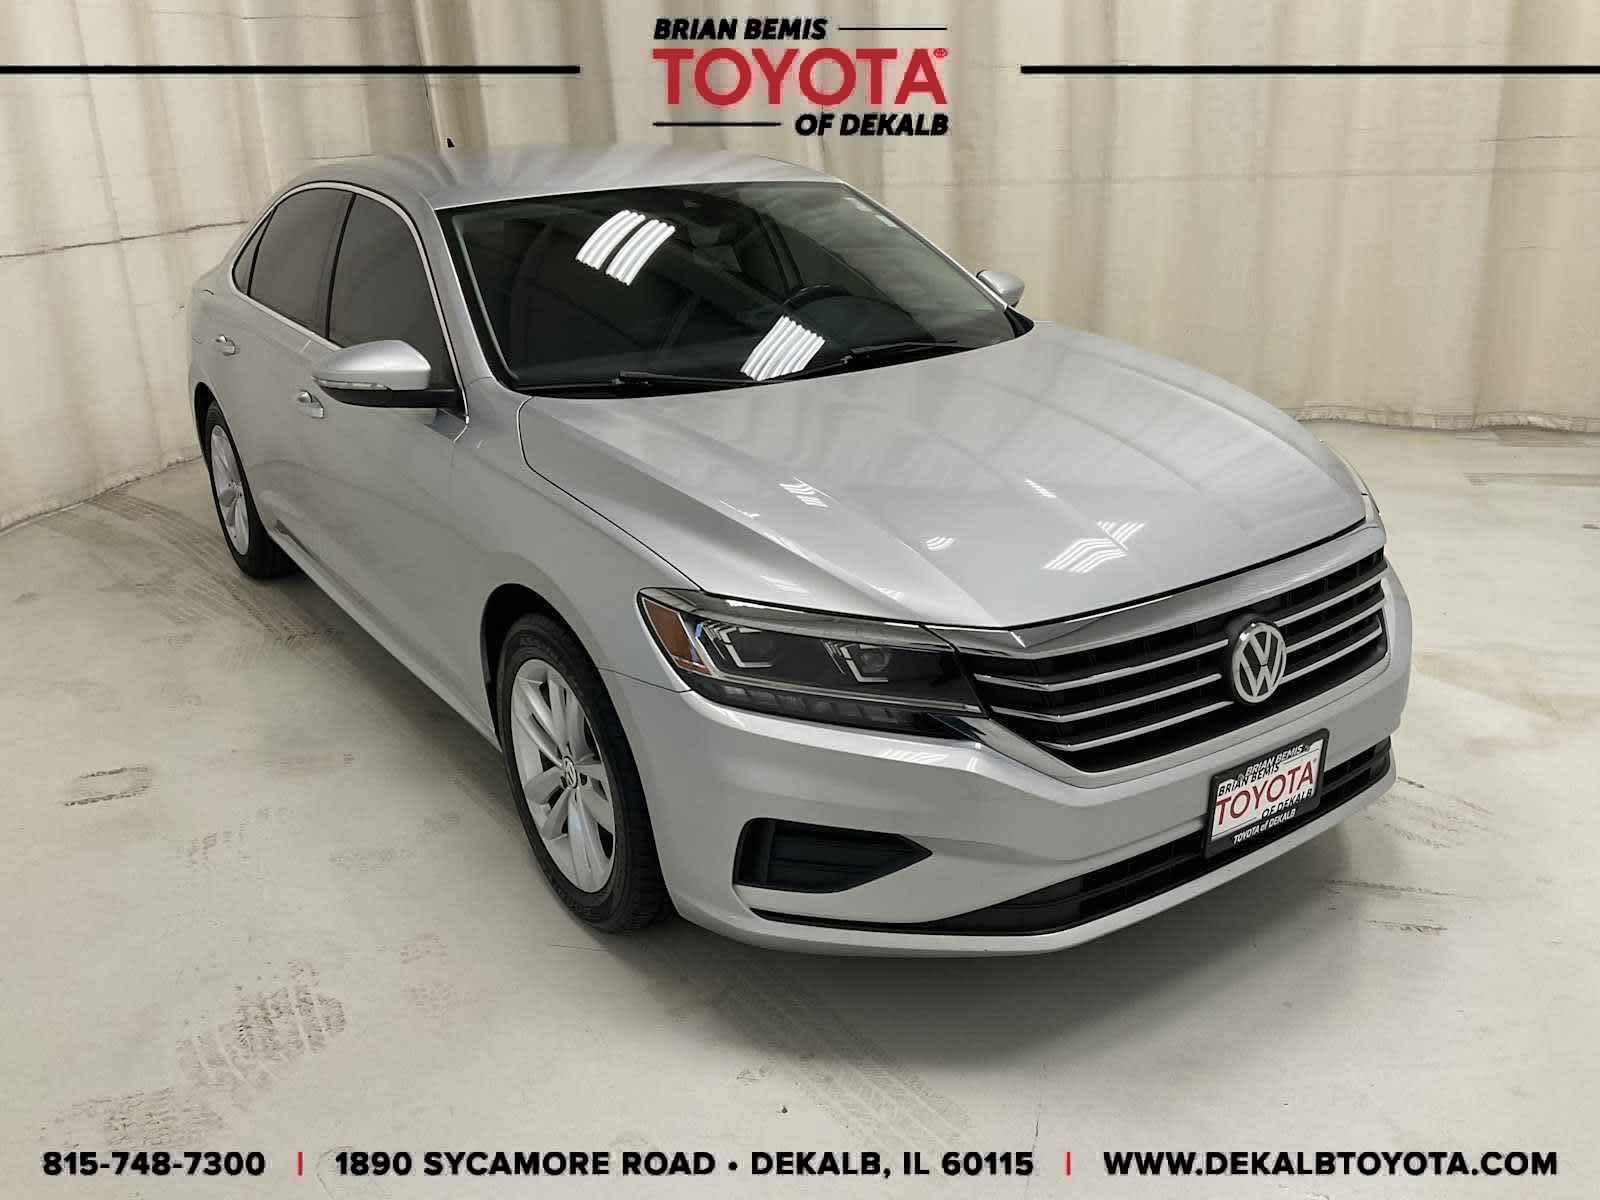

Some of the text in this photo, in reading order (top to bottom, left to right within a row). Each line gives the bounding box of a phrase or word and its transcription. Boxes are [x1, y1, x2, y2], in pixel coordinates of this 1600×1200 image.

[1245, 744, 1304, 777] BRIAN BEMIS
[1216, 761, 1313, 826] TOYOTA
[1218, 775, 1249, 796] BRIAN
[1233, 824, 1260, 845] TOYOTA
[1269, 808, 1297, 828] DEKALB
